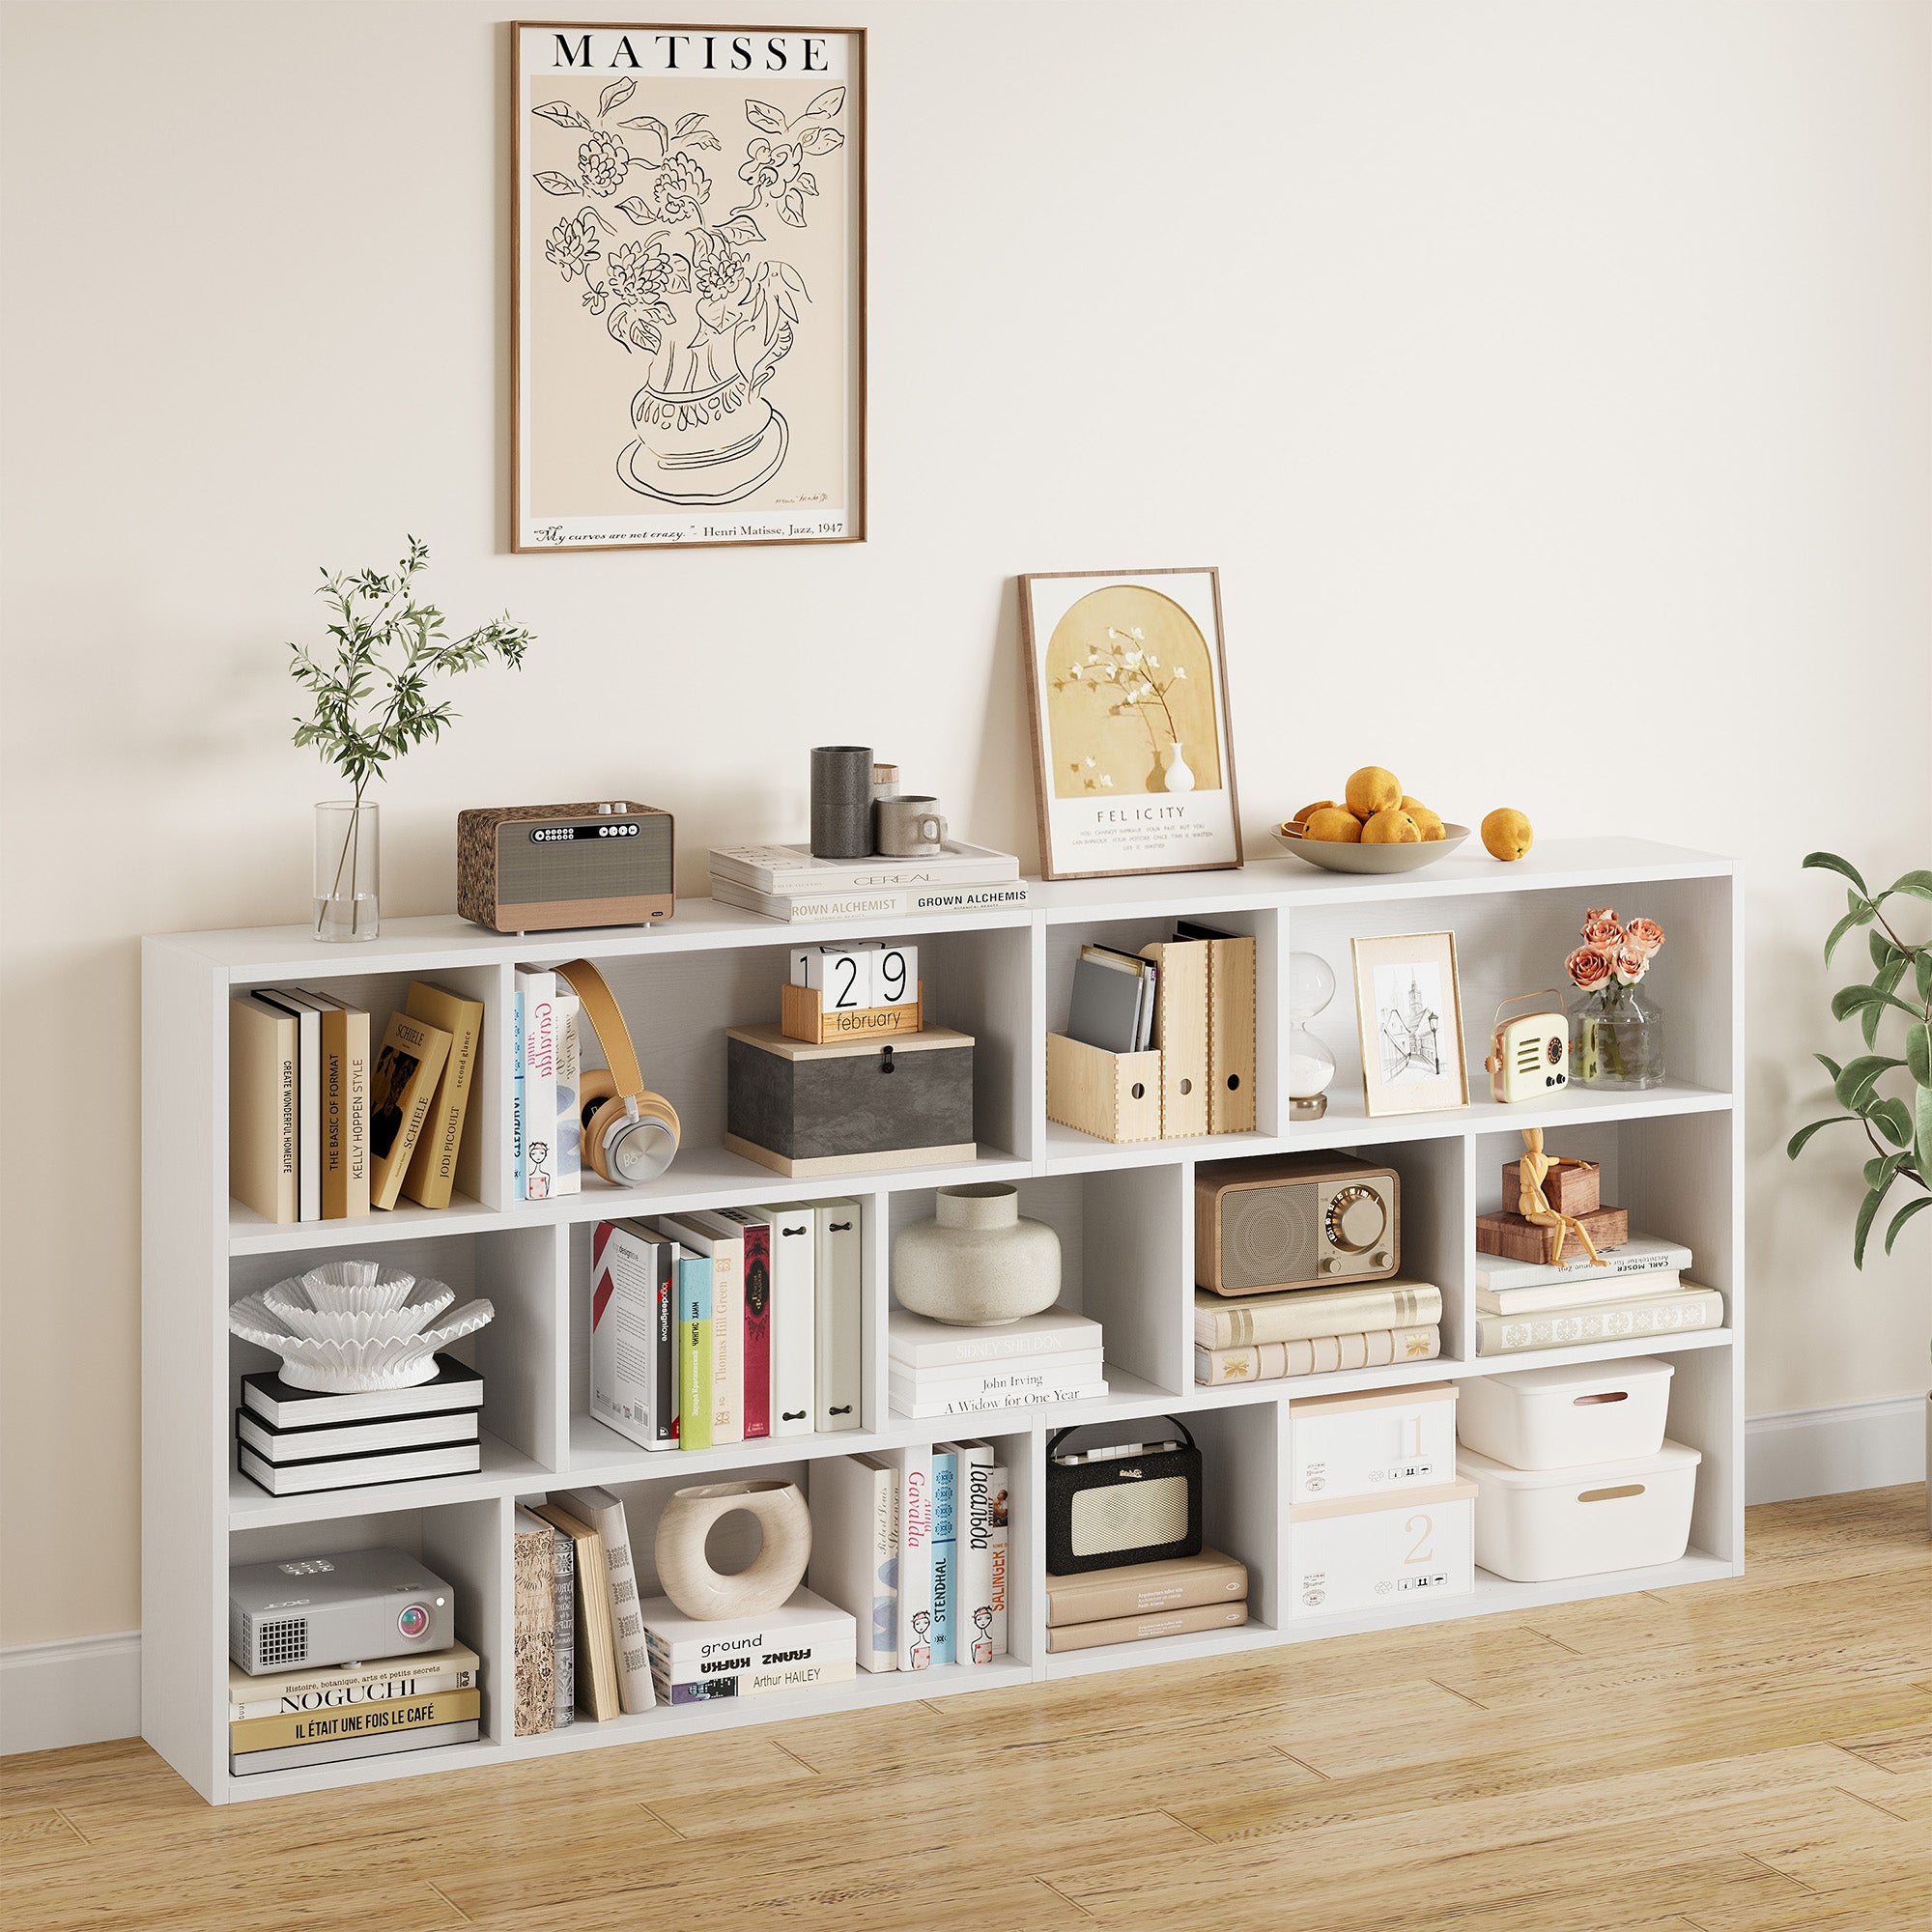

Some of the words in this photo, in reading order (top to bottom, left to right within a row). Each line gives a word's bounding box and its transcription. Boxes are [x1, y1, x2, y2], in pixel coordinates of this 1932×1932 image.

[551, 33, 829, 71] MATISSE
[703, 526, 737, 537] Henri
[741, 525, 785, 536] Matisse,
[788, 524, 814, 536] Jazz,
[818, 523, 843, 533] 1947
[1096, 807, 1185, 823] FELICITY
[853, 873, 941, 886] CEREAL
[832, 898, 897, 914] ALCHEMIST
[918, 895, 963, 908] GROWN
[395, 1022, 425, 1047] SCHIELE
[836, 1011, 901, 1032] february
[456, 1059, 466, 1088] second
[461, 1030, 471, 1059] glance
[283, 1060, 293, 1089] CREATE
[329, 1054, 339, 1096] FORMAT
[353, 1059, 363, 1093] STYLE
[283, 1091, 293, 1136] WONDERFUL
[329, 1098, 339, 1115] OF
[353, 1096, 363, 1143] HOPPEN
[329, 1117, 339, 1150] BASIC
[403, 1096, 429, 1150] SCHIELE
[444, 1105, 460, 1152] PICOULT
[283, 1137, 293, 1174] HOMELIFE
[329, 1152, 339, 1171] THE
[353, 1145, 363, 1179] KELLY
[440, 1155, 451, 1179] JODI
[1616, 1262, 1645, 1272] MOSER
[1648, 1260, 1669, 1268] CARL
[716, 1280, 727, 1315] Green
[716, 1317, 727, 1338] Hill
[956, 1341, 1000, 1359] SIDNEY
[1005, 1336, 1062, 1353] SHELDON
[716, 1340, 727, 1384] Thomas
[981, 1378, 1008, 1393] John
[1010, 1374, 1043, 1388] Irving
[944, 1403, 954, 1415] A
[958, 1398, 1001, 1412] Widow
[1004, 1394, 1022, 1407] for
[1024, 1393, 1051, 1406] One
[1053, 1389, 1080, 1402] Year
[907, 1470, 925, 1548] Gavalda
[1404, 1513, 1435, 1566] 2
[933, 1557, 947, 1624] STENDHAL
[992, 1548, 1007, 1613] SALINGER
[700, 1634, 763, 1659] ground
[761, 1648, 811, 1665] FRANZ
[286, 1682, 319, 1693] Histoire,
[321, 1678, 360, 1690] botanique,
[389, 1670, 412, 1680] petits
[413, 1665, 441, 1675] secrets
[700, 1657, 751, 1674] KAFKA
[753, 1674, 781, 1689] Arthur
[784, 1667, 822, 1685] HAILEY
[279, 1678, 417, 1715] NOGUCHI
[295, 1722, 306, 1740] IL
[308, 1717, 339, 1738] ÉTAIT
[341, 1716, 363, 1733] UNE
[365, 1712, 389, 1729] FOIS
[391, 1709, 405, 1725] LE
[407, 1702, 435, 1723] CAFÉ
